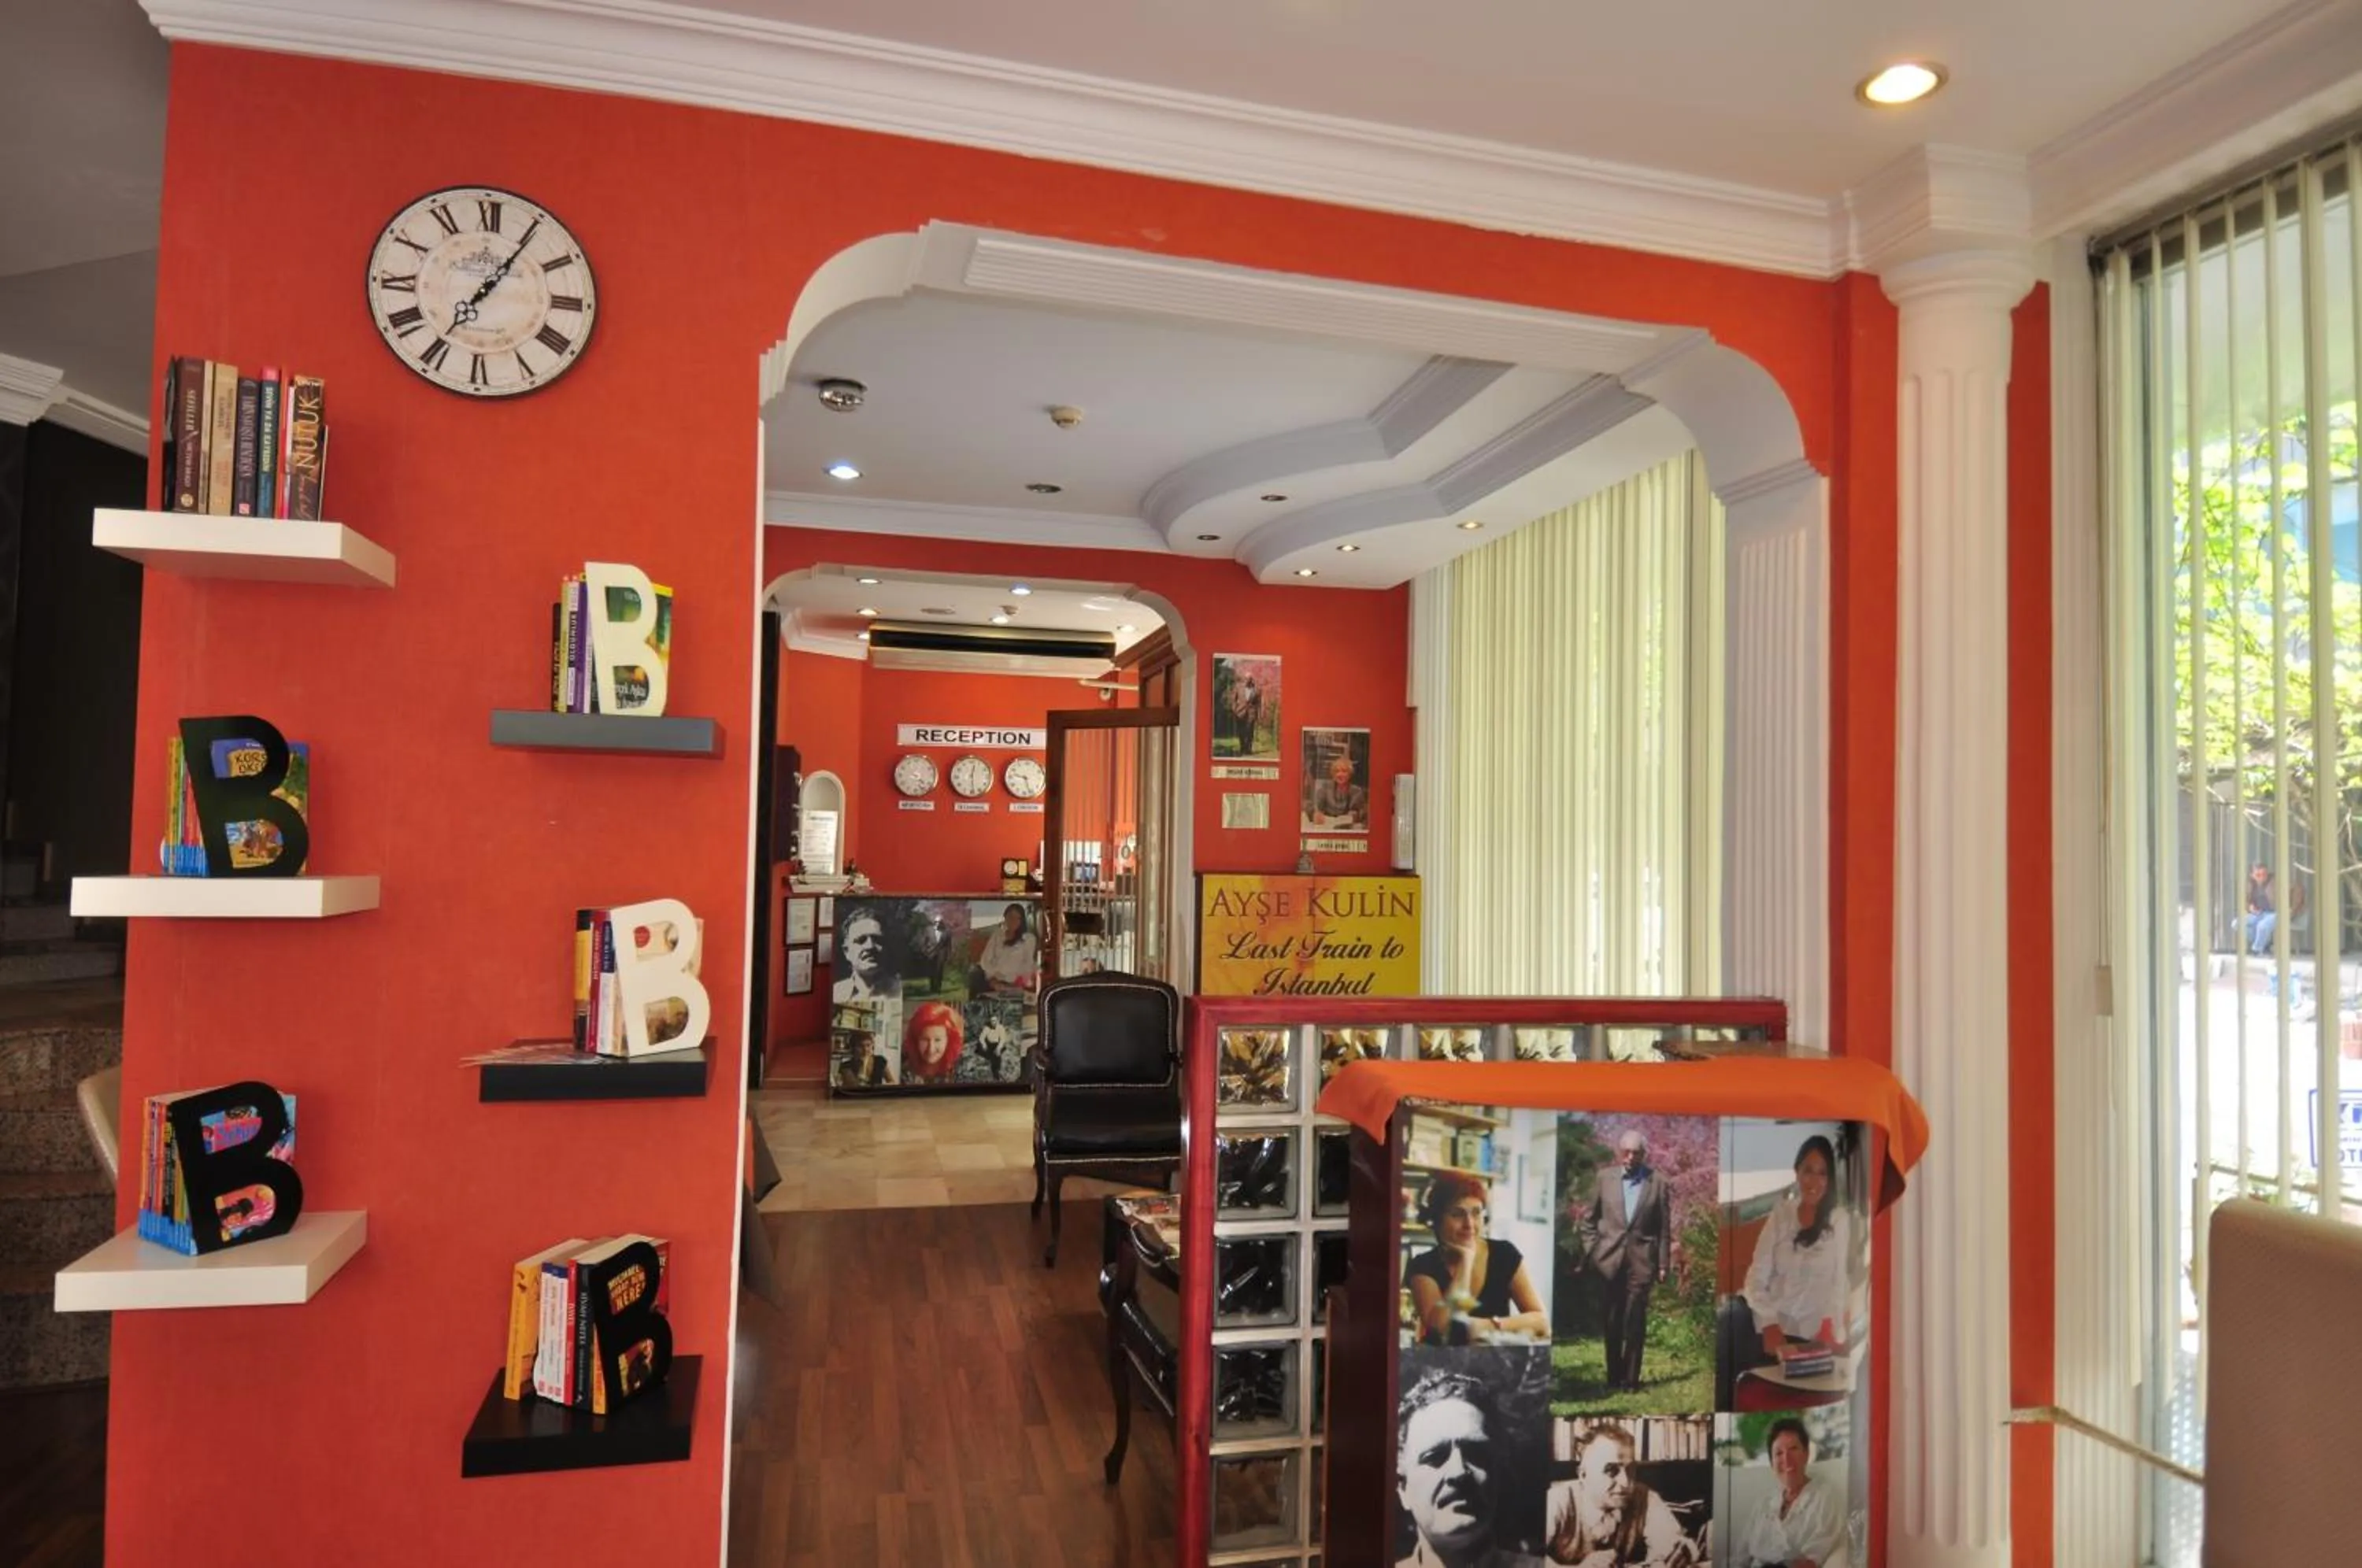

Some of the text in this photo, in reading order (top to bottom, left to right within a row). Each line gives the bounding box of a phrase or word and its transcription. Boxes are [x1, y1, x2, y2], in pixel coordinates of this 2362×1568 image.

[428, 203, 462, 239] XI
[477, 202, 502, 234] XII
[394, 227, 429, 262] X
[541, 252, 573, 273] II
[380, 270, 416, 293] IX
[550, 294, 583, 312] III
[387, 305, 425, 340] VIII
[418, 335, 451, 372] VII
[470, 353, 488, 386] VI
[514, 349, 535, 380] V
[296, 395, 320, 468] NUTUK
[915, 729, 1031, 745] RECEPTION
[1208, 885, 1415, 924] AYŞE KULİN
[1220, 930, 1405, 960] Last Train to
[1253, 967, 1375, 996] Istanbul
